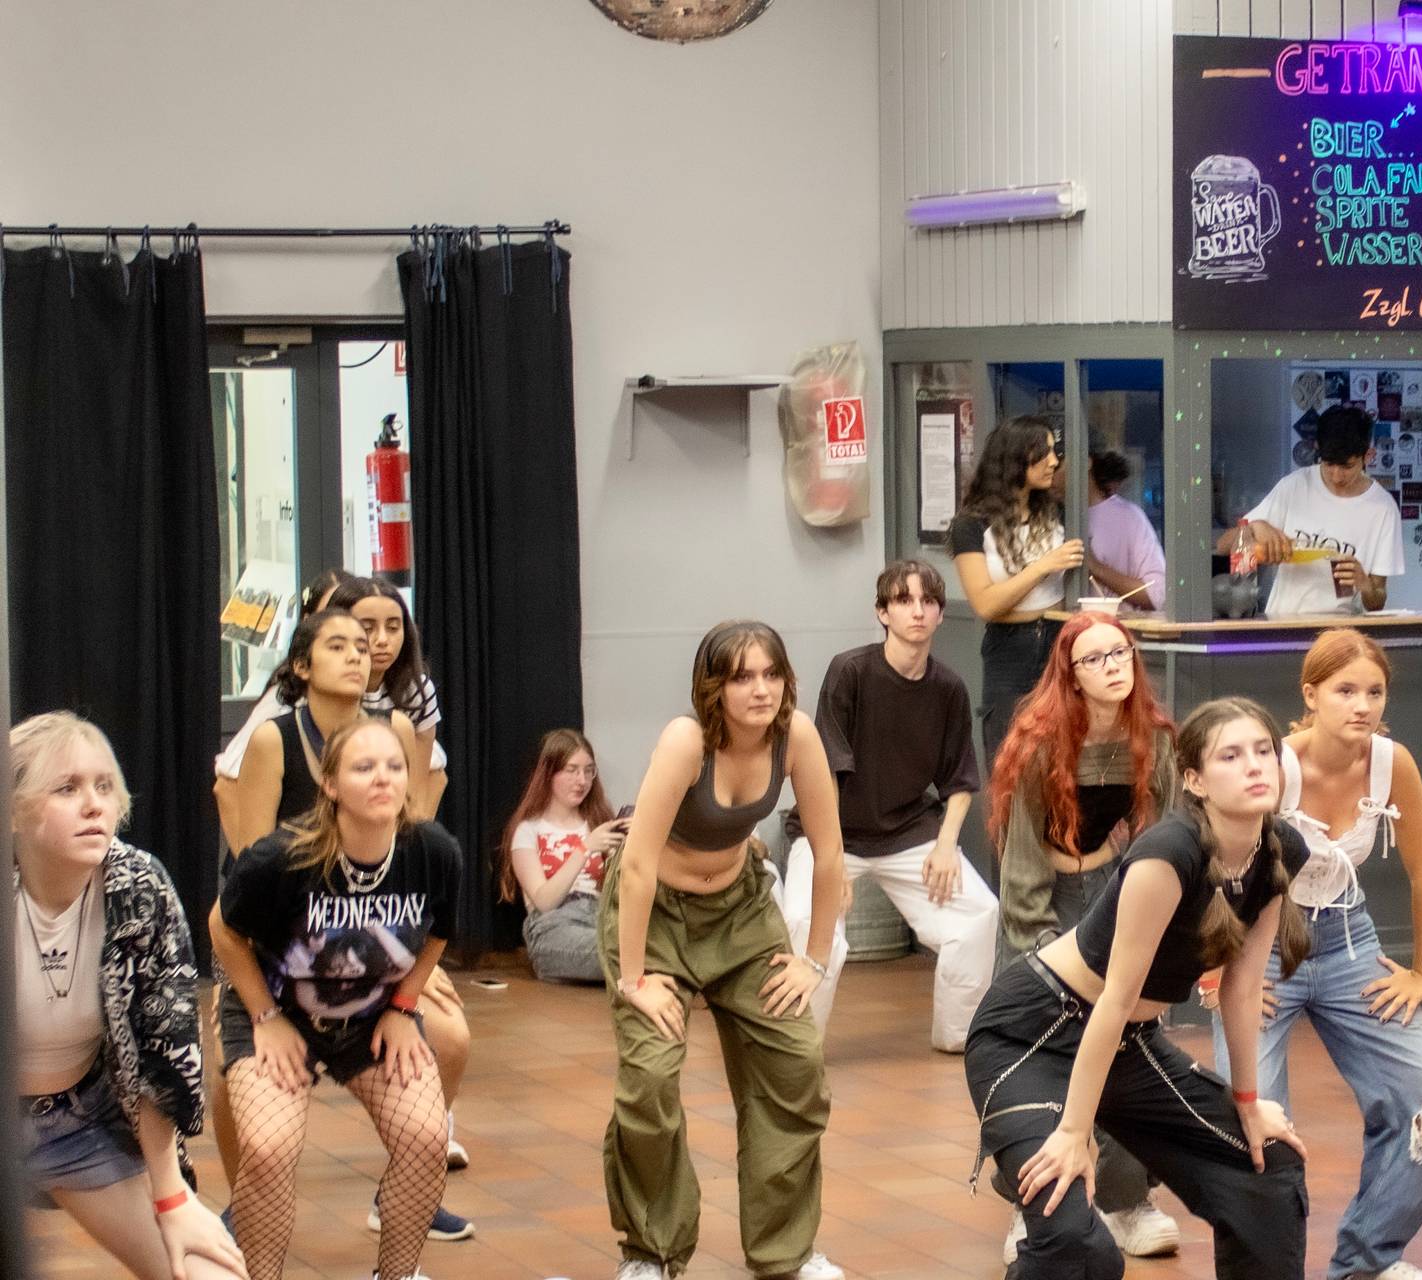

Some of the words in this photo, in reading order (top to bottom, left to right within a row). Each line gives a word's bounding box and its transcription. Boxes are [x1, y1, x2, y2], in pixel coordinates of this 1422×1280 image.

[1310, 117, 1386, 158] BIER
[1315, 196, 1410, 233] SPRITE
[1195, 225, 1257, 260] BEER
[830, 443, 866, 458] TOTAL
[307, 891, 426, 934] WEDNESDAY
